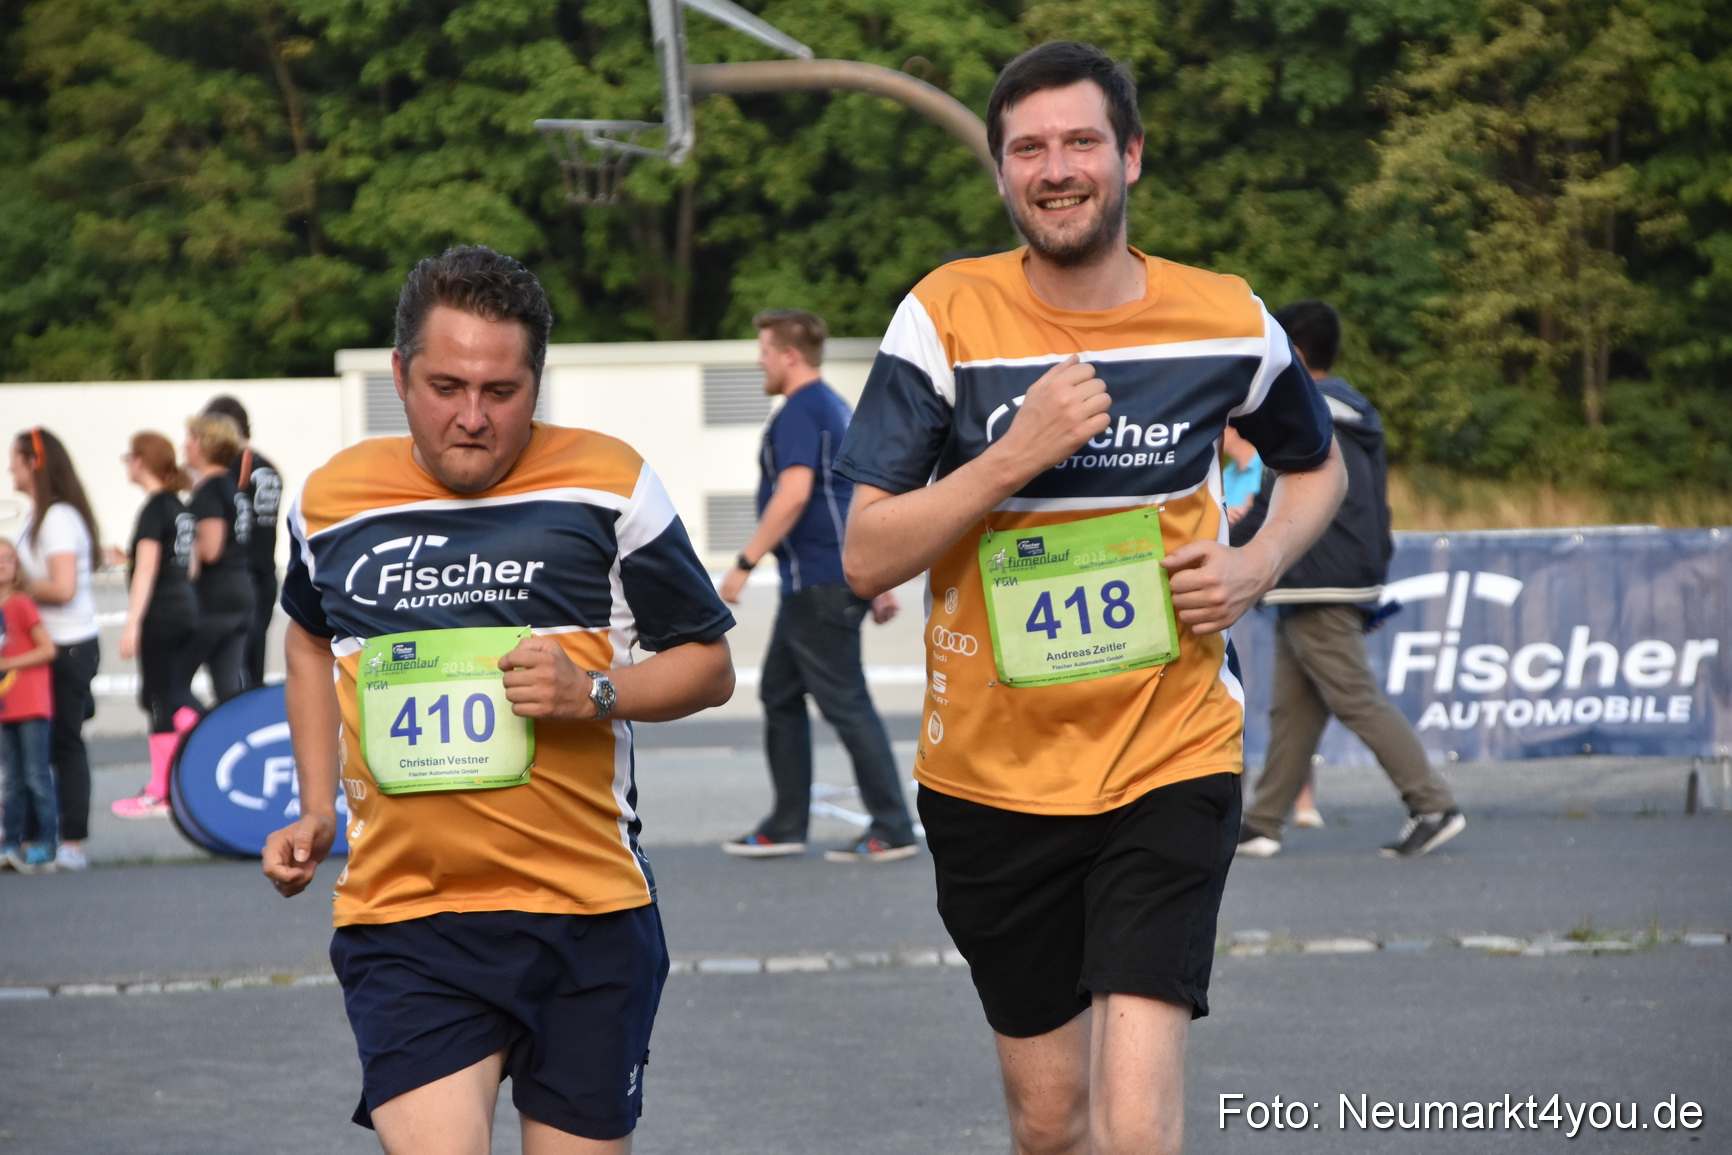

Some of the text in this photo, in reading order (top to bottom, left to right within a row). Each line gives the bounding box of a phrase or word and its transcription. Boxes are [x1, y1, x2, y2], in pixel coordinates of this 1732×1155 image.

[1088, 415, 1190, 449] cher
[1054, 450, 1176, 469] UTOMOBILE
[1008, 548, 1071, 568] firmenlauf
[1073, 550, 1107, 566] 2015
[377, 552, 545, 595] Fischer
[393, 587, 530, 612] AUTOMOBILE
[1025, 579, 1136, 640] 418
[1046, 641, 1127, 662] Andreas Zeitler
[1052, 662, 1073, 671] Fischer
[1074, 658, 1106, 668] Automobile
[1106, 653, 1124, 663] GmbH
[1386, 624, 1719, 695] Fischer
[381, 655, 440, 672] firmenlauf
[389, 692, 496, 747] 410
[1417, 695, 1693, 731] AUTOMOBILE
[399, 754, 490, 769] Christian Vestner
[428, 769, 460, 777] Automobile
